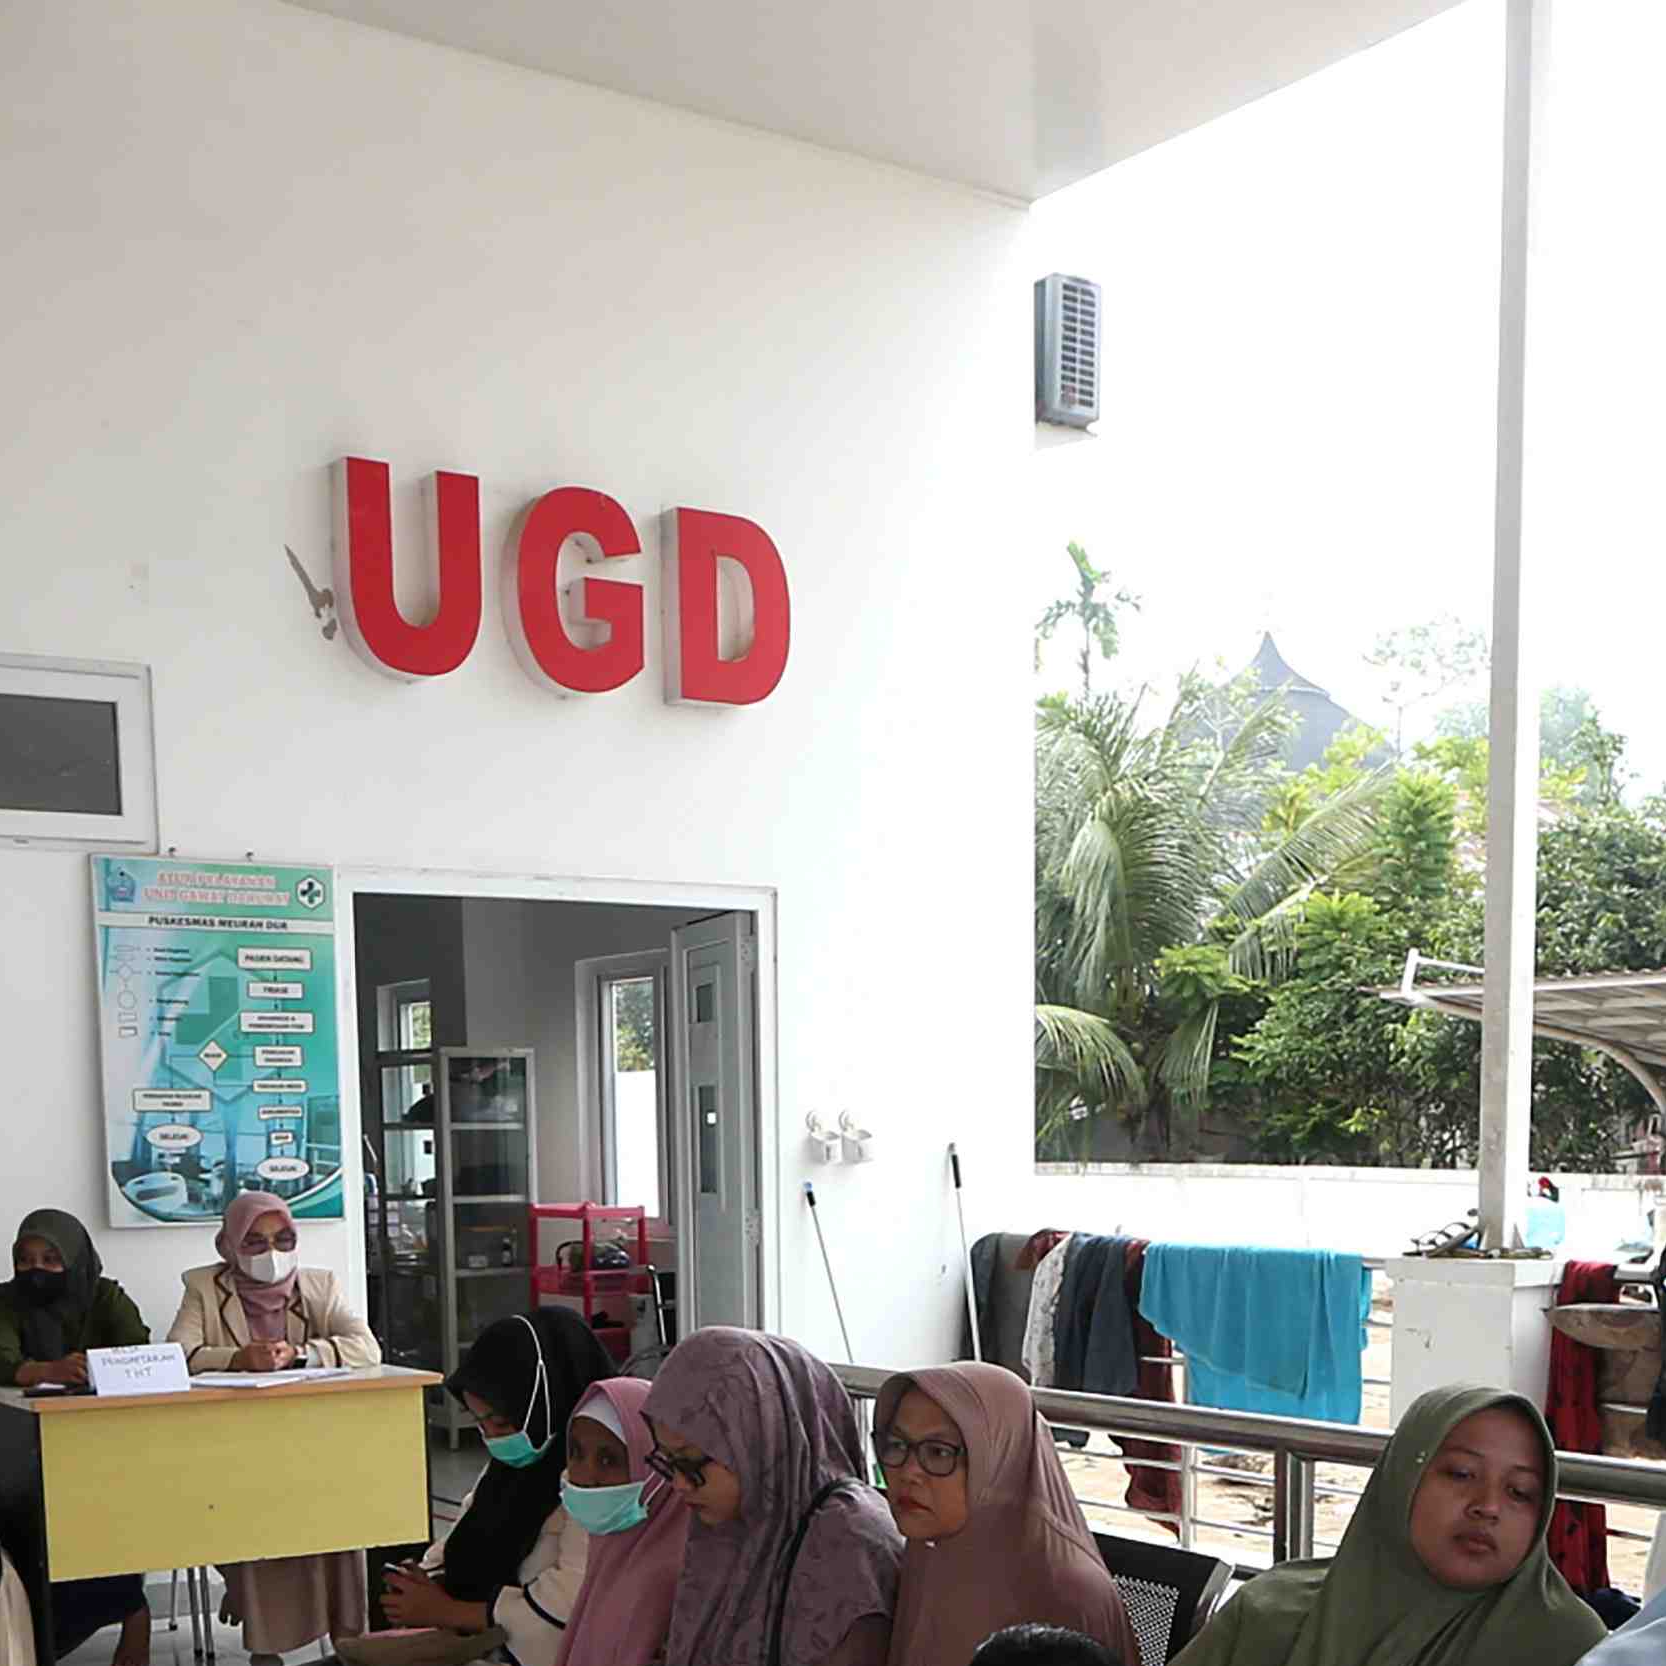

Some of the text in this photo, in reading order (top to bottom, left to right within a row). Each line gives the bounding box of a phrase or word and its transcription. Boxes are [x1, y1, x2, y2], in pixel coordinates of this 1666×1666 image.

[329, 455, 792, 709] UGD
[148, 916, 215, 928] PUSKESMAS
[218, 918, 264, 929] MEURAH
